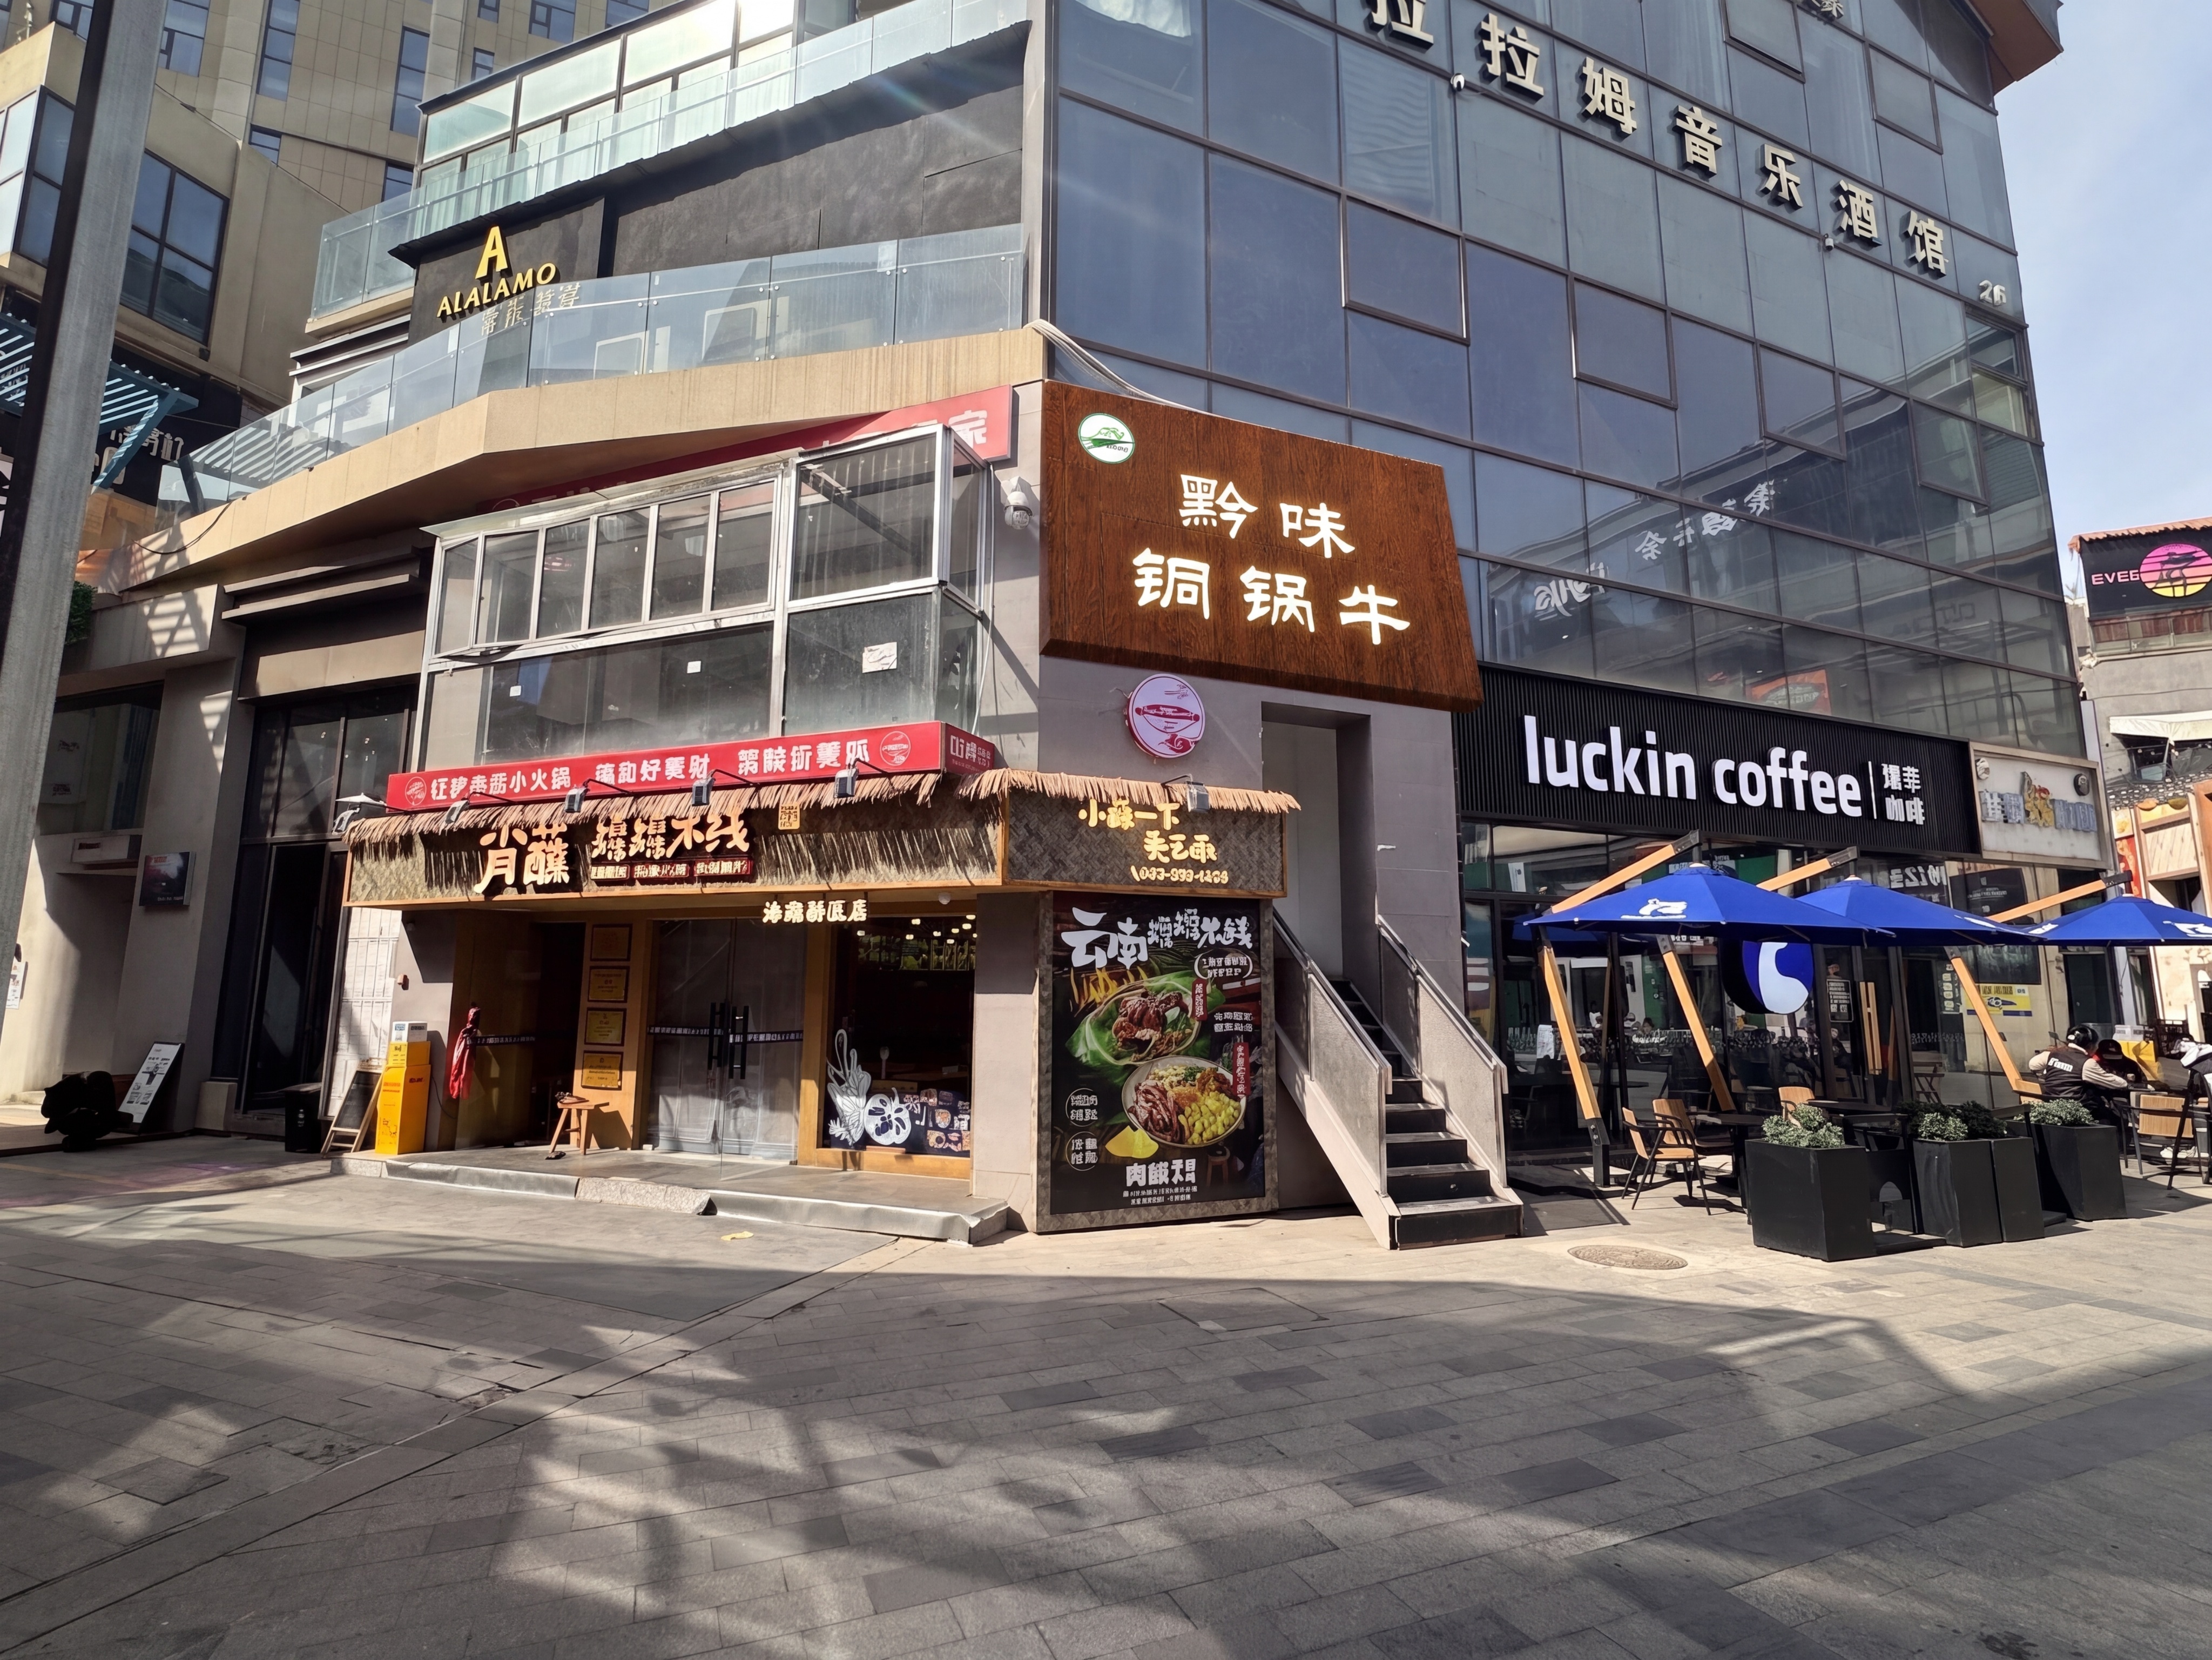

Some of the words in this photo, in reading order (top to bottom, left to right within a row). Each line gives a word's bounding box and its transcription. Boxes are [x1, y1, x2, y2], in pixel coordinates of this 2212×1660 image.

[436, 263, 556, 318] ALALAMO
[1179, 474, 1355, 559] 黔味
[1132, 547, 1411, 645] 铜锅牛
[1523, 715, 1697, 801] luckin
[1712, 747, 1863, 817] coffee
[1885, 794, 1925, 825] 咖啡
